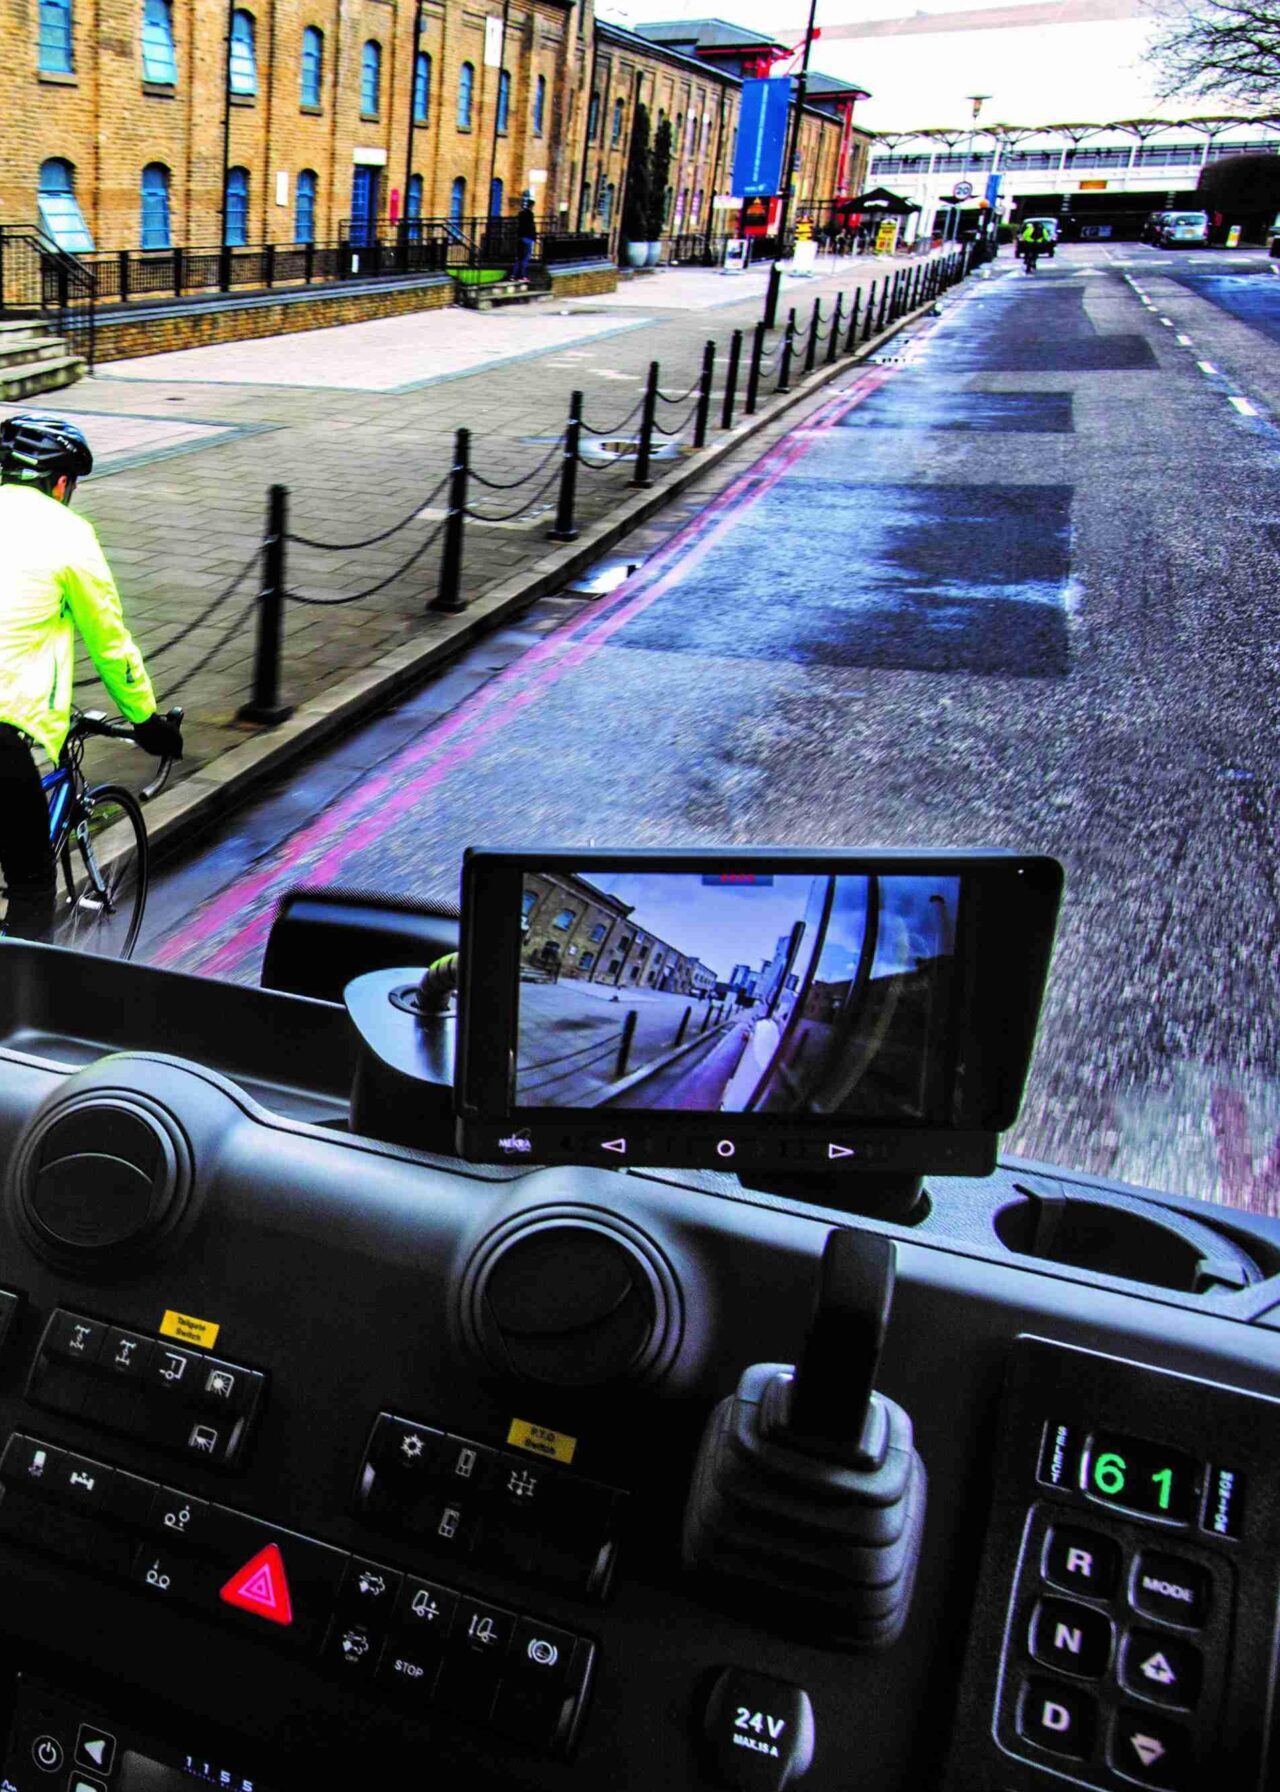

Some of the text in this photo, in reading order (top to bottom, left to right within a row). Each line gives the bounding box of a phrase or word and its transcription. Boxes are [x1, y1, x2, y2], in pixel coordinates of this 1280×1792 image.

[956, 187, 969, 195] 20
[1094, 1453, 1172, 1509] 6 1
[1066, 1547, 1093, 1577] R
[1142, 1575, 1195, 1603] MODE
[1054, 1622, 1082, 1653] N
[395, 1659, 424, 1677] STOP
[734, 1706, 785, 1739] 24V
[1041, 1700, 1070, 1731] D
